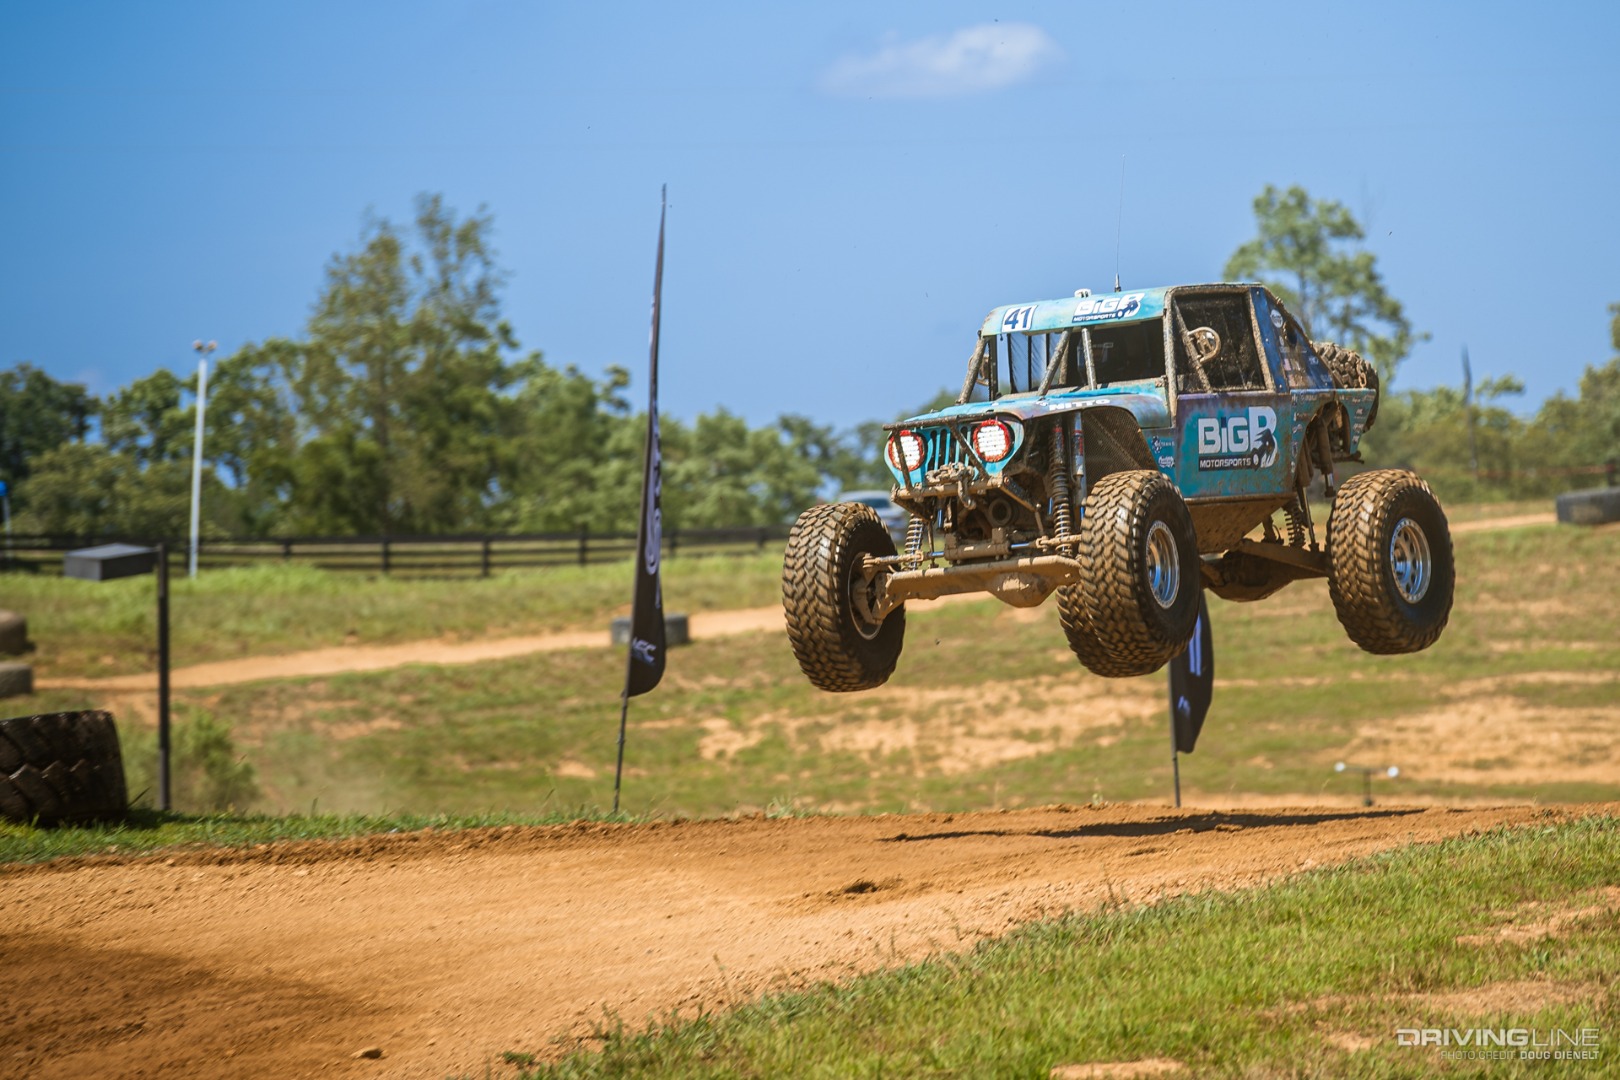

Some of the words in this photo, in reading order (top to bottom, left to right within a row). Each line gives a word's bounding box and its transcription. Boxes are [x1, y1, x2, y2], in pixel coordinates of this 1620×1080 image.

[1004, 307, 1032, 329] 41
[1073, 313, 1116, 321] MOTORSPORTS
[1049, 400, 1110, 411] NITTO
[1200, 458, 1251, 467] MOTORSPORTS
